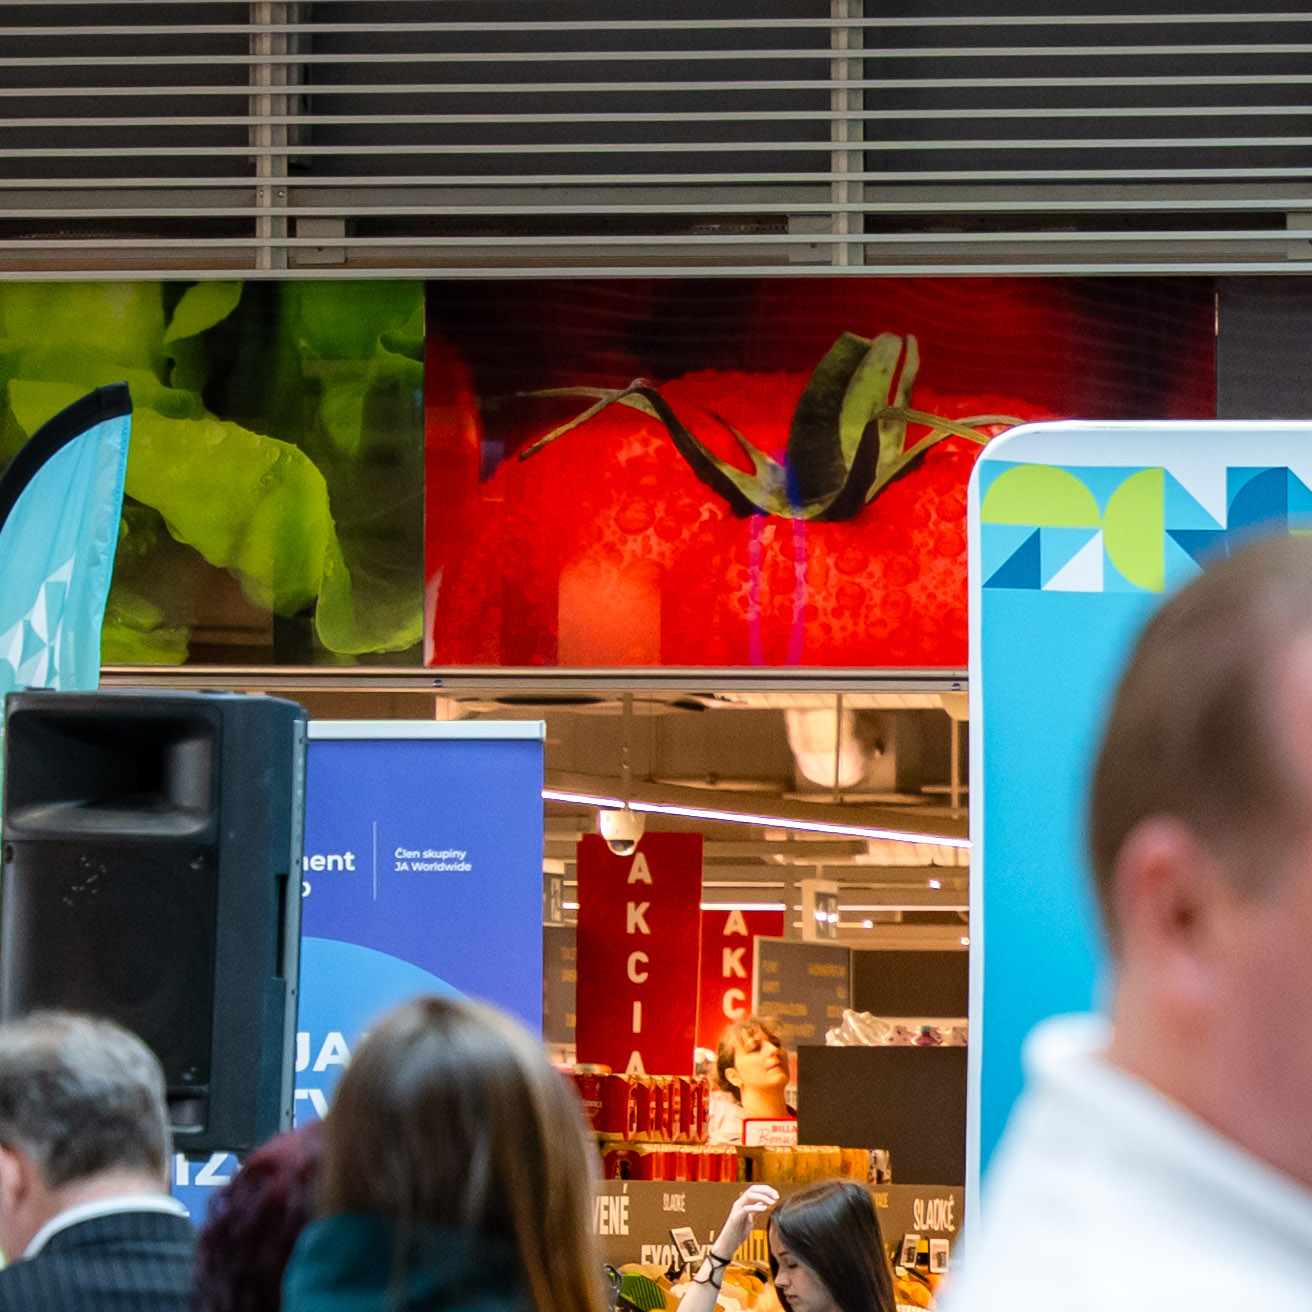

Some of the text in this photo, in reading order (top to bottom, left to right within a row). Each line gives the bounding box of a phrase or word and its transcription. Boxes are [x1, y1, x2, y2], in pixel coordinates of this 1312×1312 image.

[302, 851, 356, 872] ent
[394, 847, 467, 860] Člen skupiny
[394, 861, 473, 872] JA Worldwide
[625, 851, 653, 1075] AKCIA
[722, 910, 749, 1020] AKC
[913, 1194, 955, 1232] SLADKÉ
